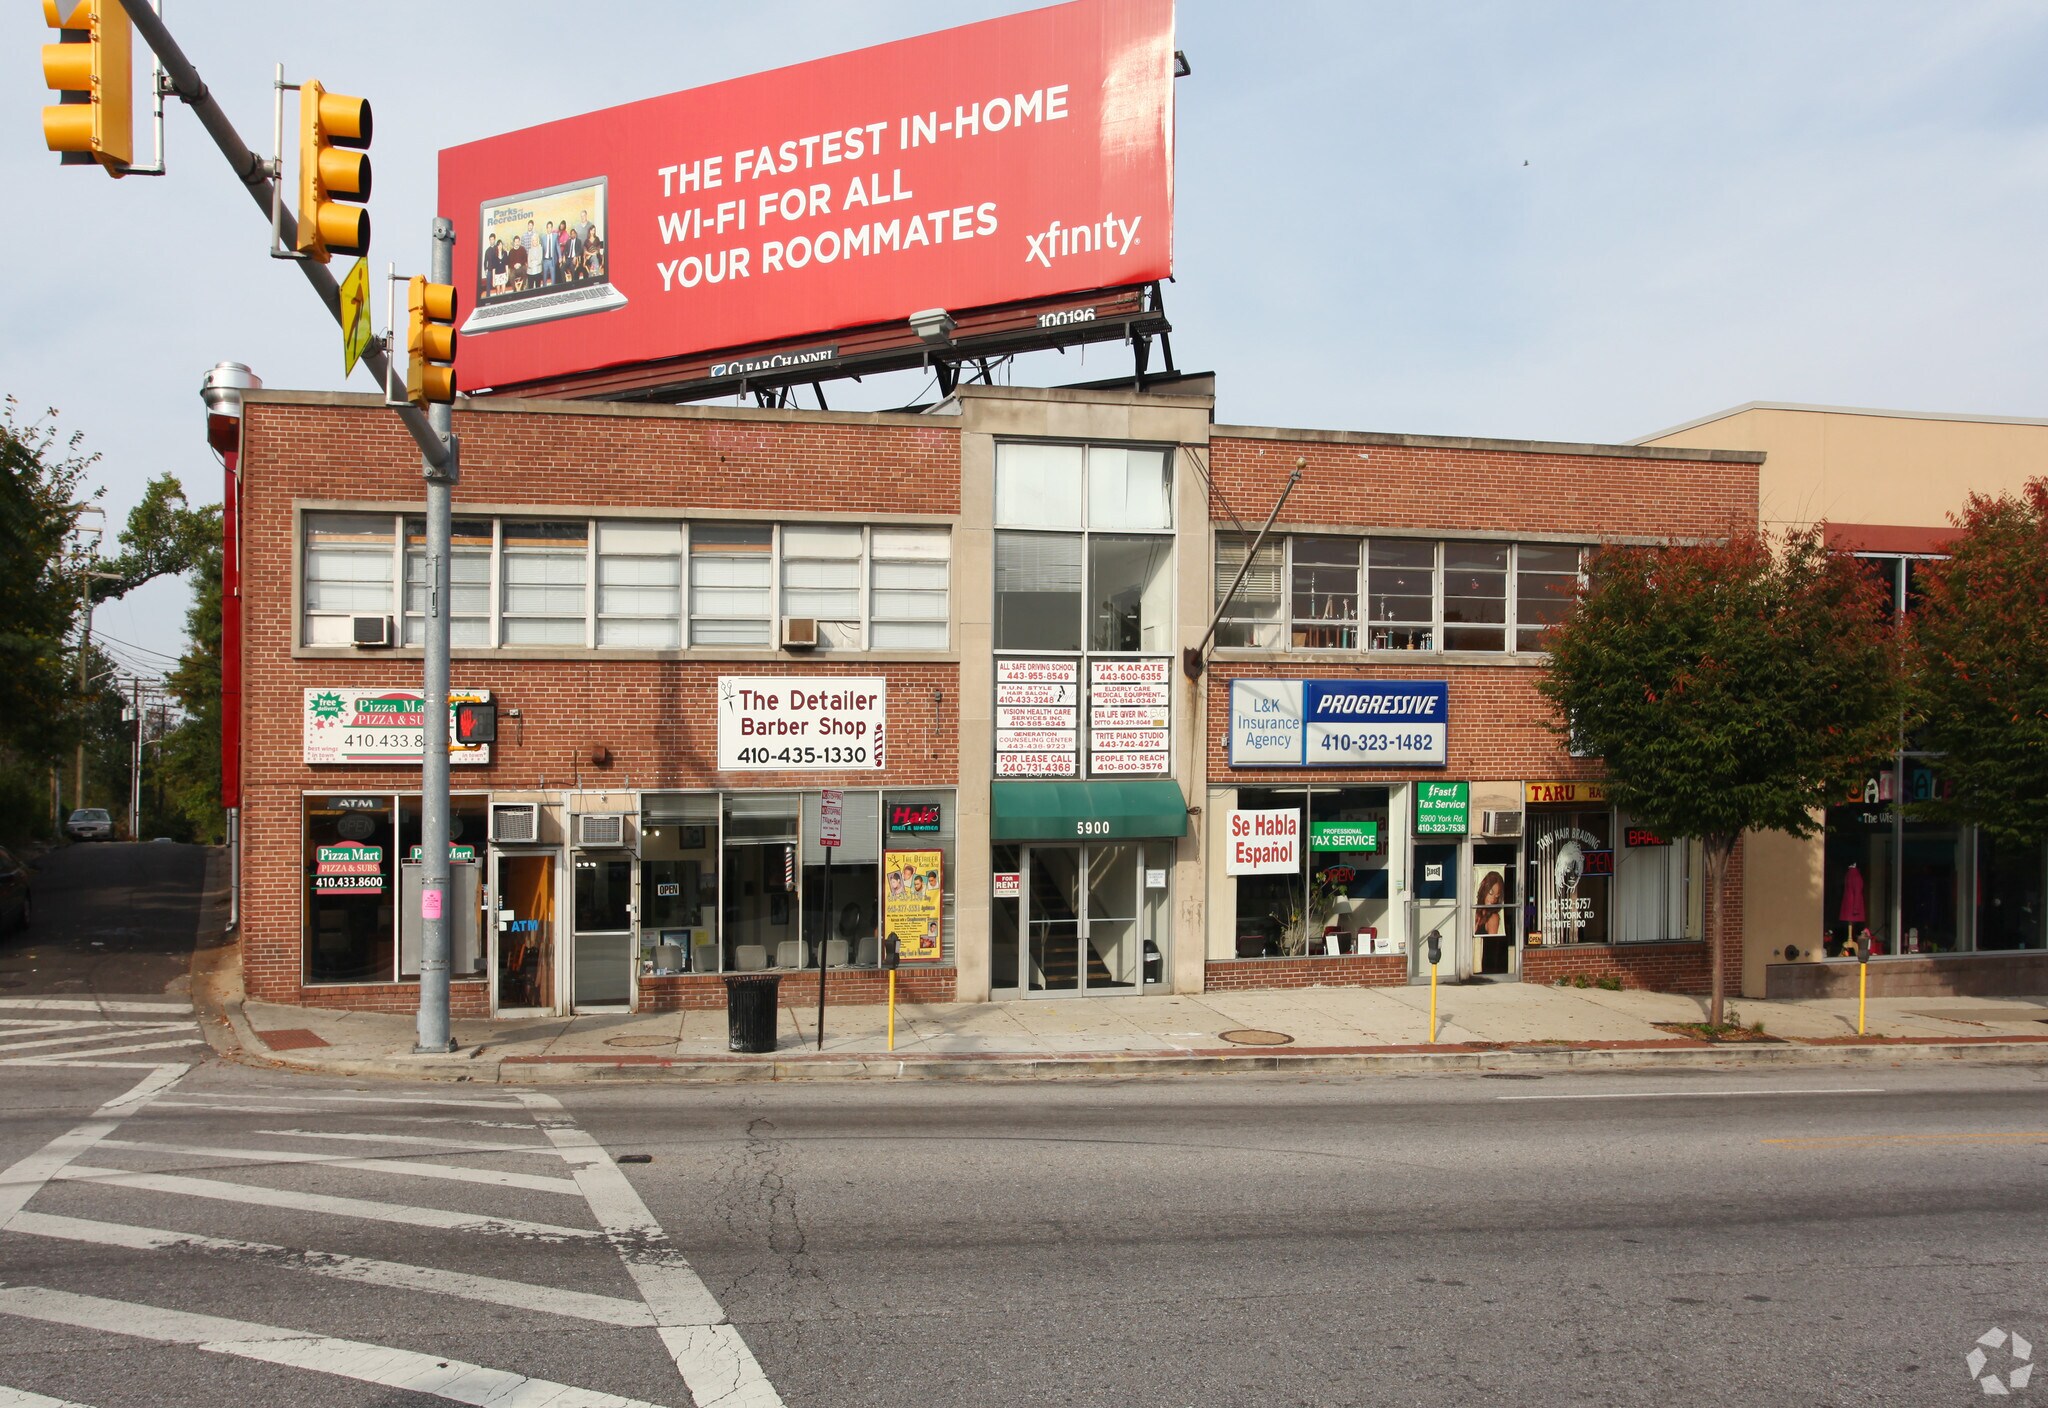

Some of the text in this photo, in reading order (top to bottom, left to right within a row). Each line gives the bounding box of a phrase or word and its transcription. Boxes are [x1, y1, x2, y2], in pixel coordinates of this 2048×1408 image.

[658, 84, 1069, 198] THE FASTEST IN-HOME
[657, 168, 913, 245] WI-FI FOR ALL
[487, 210, 534, 226] Recreation
[494, 207, 517, 218] Parks
[1025, 211, 1142, 268] xfinity
[657, 202, 998, 292] YOUR ROOMMATES
[1038, 307, 1095, 327] 100196
[1051, 664, 1075, 672] SCHOOL
[1094, 664, 1165, 672] TJK KARATE
[1007, 672, 1069, 680] 443-955-8549
[1100, 672, 1162, 680] 443-600-6355
[318, 698, 337, 708] free
[739, 689, 877, 711] The Detailer
[999, 696, 1054, 704] 410-433-3248
[1316, 694, 1439, 715] PROGRESSIVE
[317, 705, 339, 713] delivery
[357, 699, 398, 714] Pizza
[1253, 699, 1280, 713] L&K
[1003, 708, 1072, 716] VISION HEALTH CARE
[1094, 710, 1106, 718] EVA
[1107, 710, 1118, 718] LIFE
[1120, 710, 1136, 718] GIVER
[357, 714, 396, 726] PIZZA
[397, 714, 406, 726] &
[1238, 715, 1300, 730] Insurance
[741, 717, 867, 739] Barber Shop
[1096, 732, 1114, 740] TRITE
[1116, 732, 1138, 740] PIANO
[1245, 732, 1292, 749] Agency
[1099, 740, 1160, 748] 443-742-4274
[1321, 734, 1433, 751] 410-323-1482
[320, 746, 338, 754] wings
[737, 746, 867, 764] 410-435-1330
[1000, 754, 1072, 762] FOR LEASE CALL
[1127, 754, 1138, 762] TO
[1139, 754, 1165, 762] REACH
[1002, 763, 1071, 772] 240-731-4368
[1097, 762, 1163, 770] 410-800-3576
[1433, 788, 1452, 796] Fast
[1531, 784, 1576, 800] TARU
[338, 799, 373, 808] ATM
[1419, 800, 1466, 808] Tax Service
[893, 806, 938, 824] Hair
[1420, 814, 1464, 822] 5900 York Rd.
[1863, 813, 1878, 824] The
[338, 819, 374, 833] OPEN
[1077, 821, 1110, 834] 5900
[1232, 814, 1296, 836] Se Habla
[1418, 824, 1466, 832] 410-323-7538
[1310, 836, 1376, 846] TAX SERVICE
[1537, 828, 1600, 850] TARU HAIR BRAIDING
[320, 848, 379, 861] Pizza Mart
[1235, 840, 1293, 868] Español
[321, 863, 377, 873] PIZZA & SUBS
[1426, 866, 1441, 877] CLOSED
[1324, 868, 1356, 882] OPEN
[316, 876, 383, 888] 410.433.8600
[659, 885, 678, 895] OPEN
[1562, 911, 1582, 920] YORK
[511, 920, 538, 932] ATM
[1552, 920, 1571, 928] SUITE
